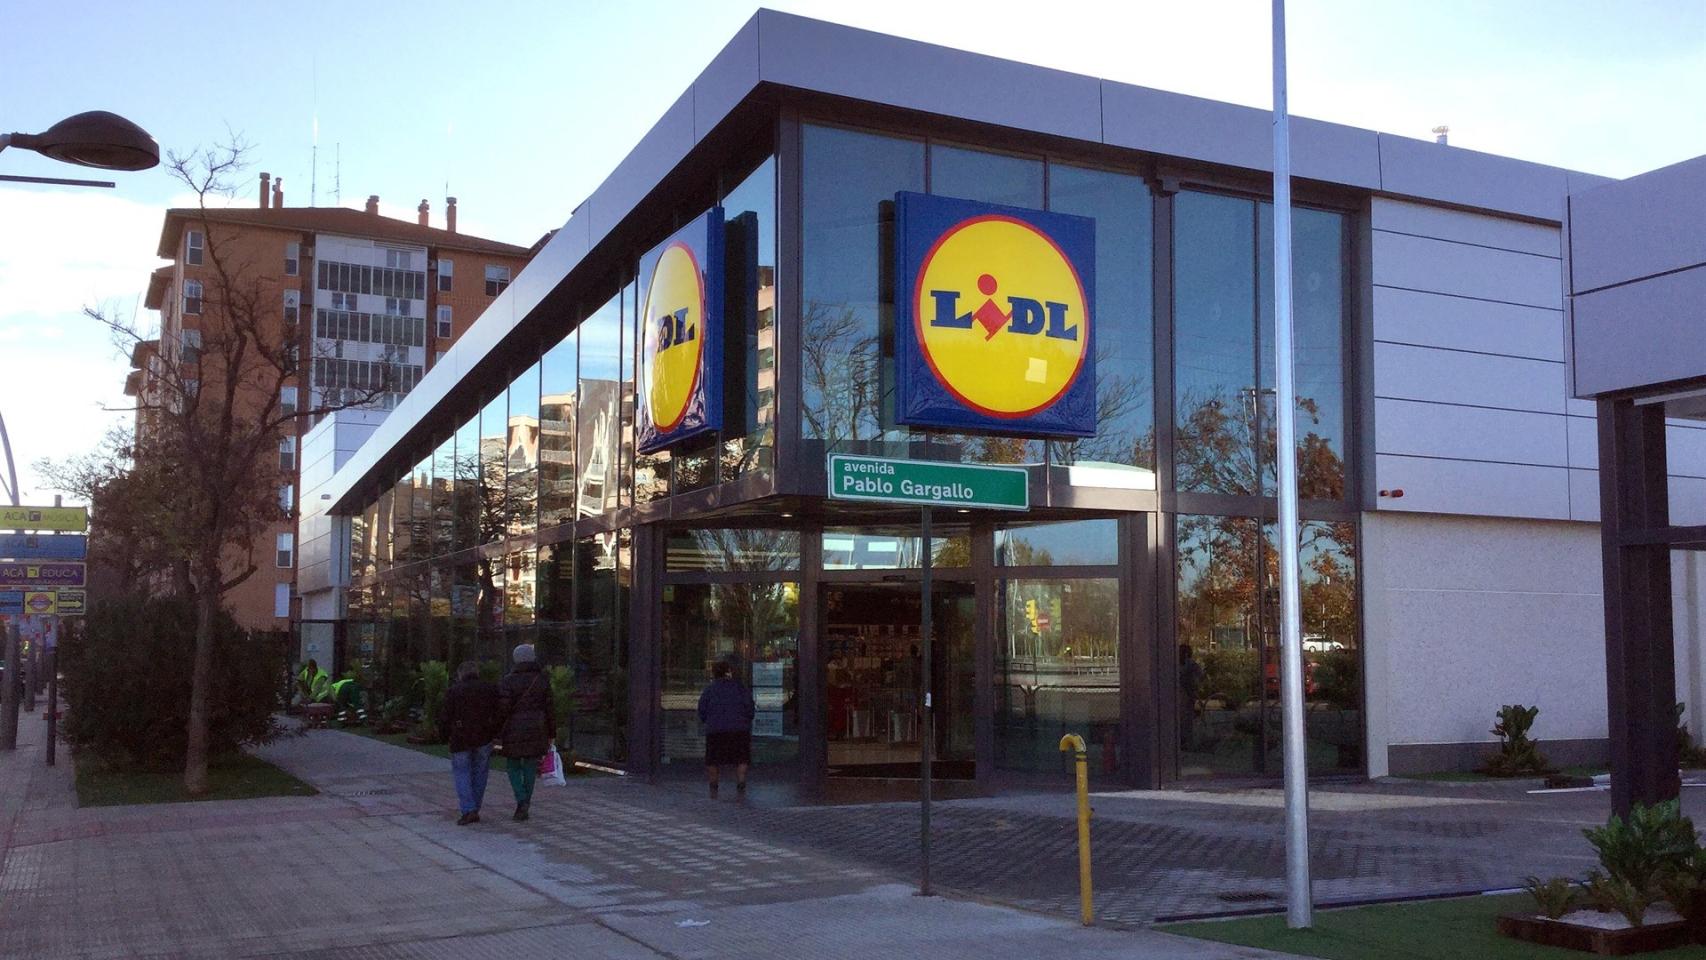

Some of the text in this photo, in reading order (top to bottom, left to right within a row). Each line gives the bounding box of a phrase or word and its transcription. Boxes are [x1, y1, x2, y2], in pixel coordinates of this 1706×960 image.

[930, 274, 1078, 342] LIDL
[843, 461, 895, 475] avenida
[843, 475, 974, 500] Pablo Gargallo
[4, 511, 27, 520] ACA
[2, 568, 78, 577] ACA EDUCA
